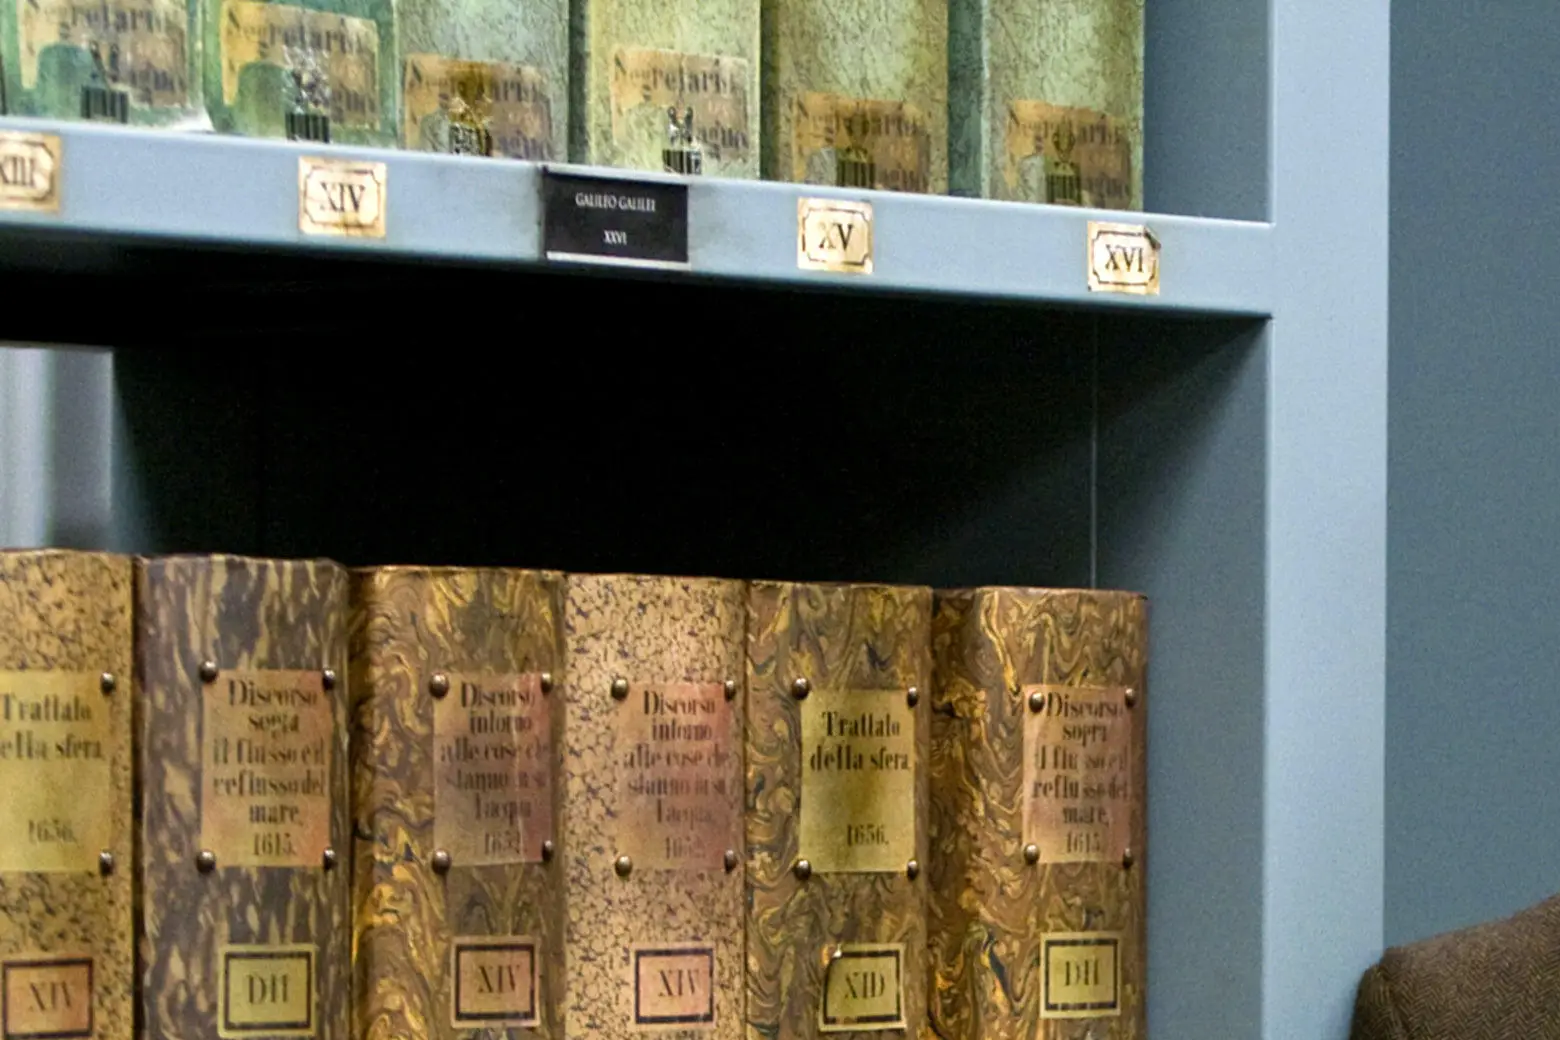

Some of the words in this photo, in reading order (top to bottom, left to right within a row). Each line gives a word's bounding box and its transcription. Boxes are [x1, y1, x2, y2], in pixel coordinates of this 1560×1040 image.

[320, 182, 366, 213] XIV
[575, 192, 616, 210] GALILEO
[618, 195, 656, 212] GALILEI
[818, 221, 854, 252] XV
[1104, 243, 1146, 274] XVI
[810, 744, 864, 772] della
[477, 964, 520, 995] XIV
[658, 968, 700, 998] XIV
